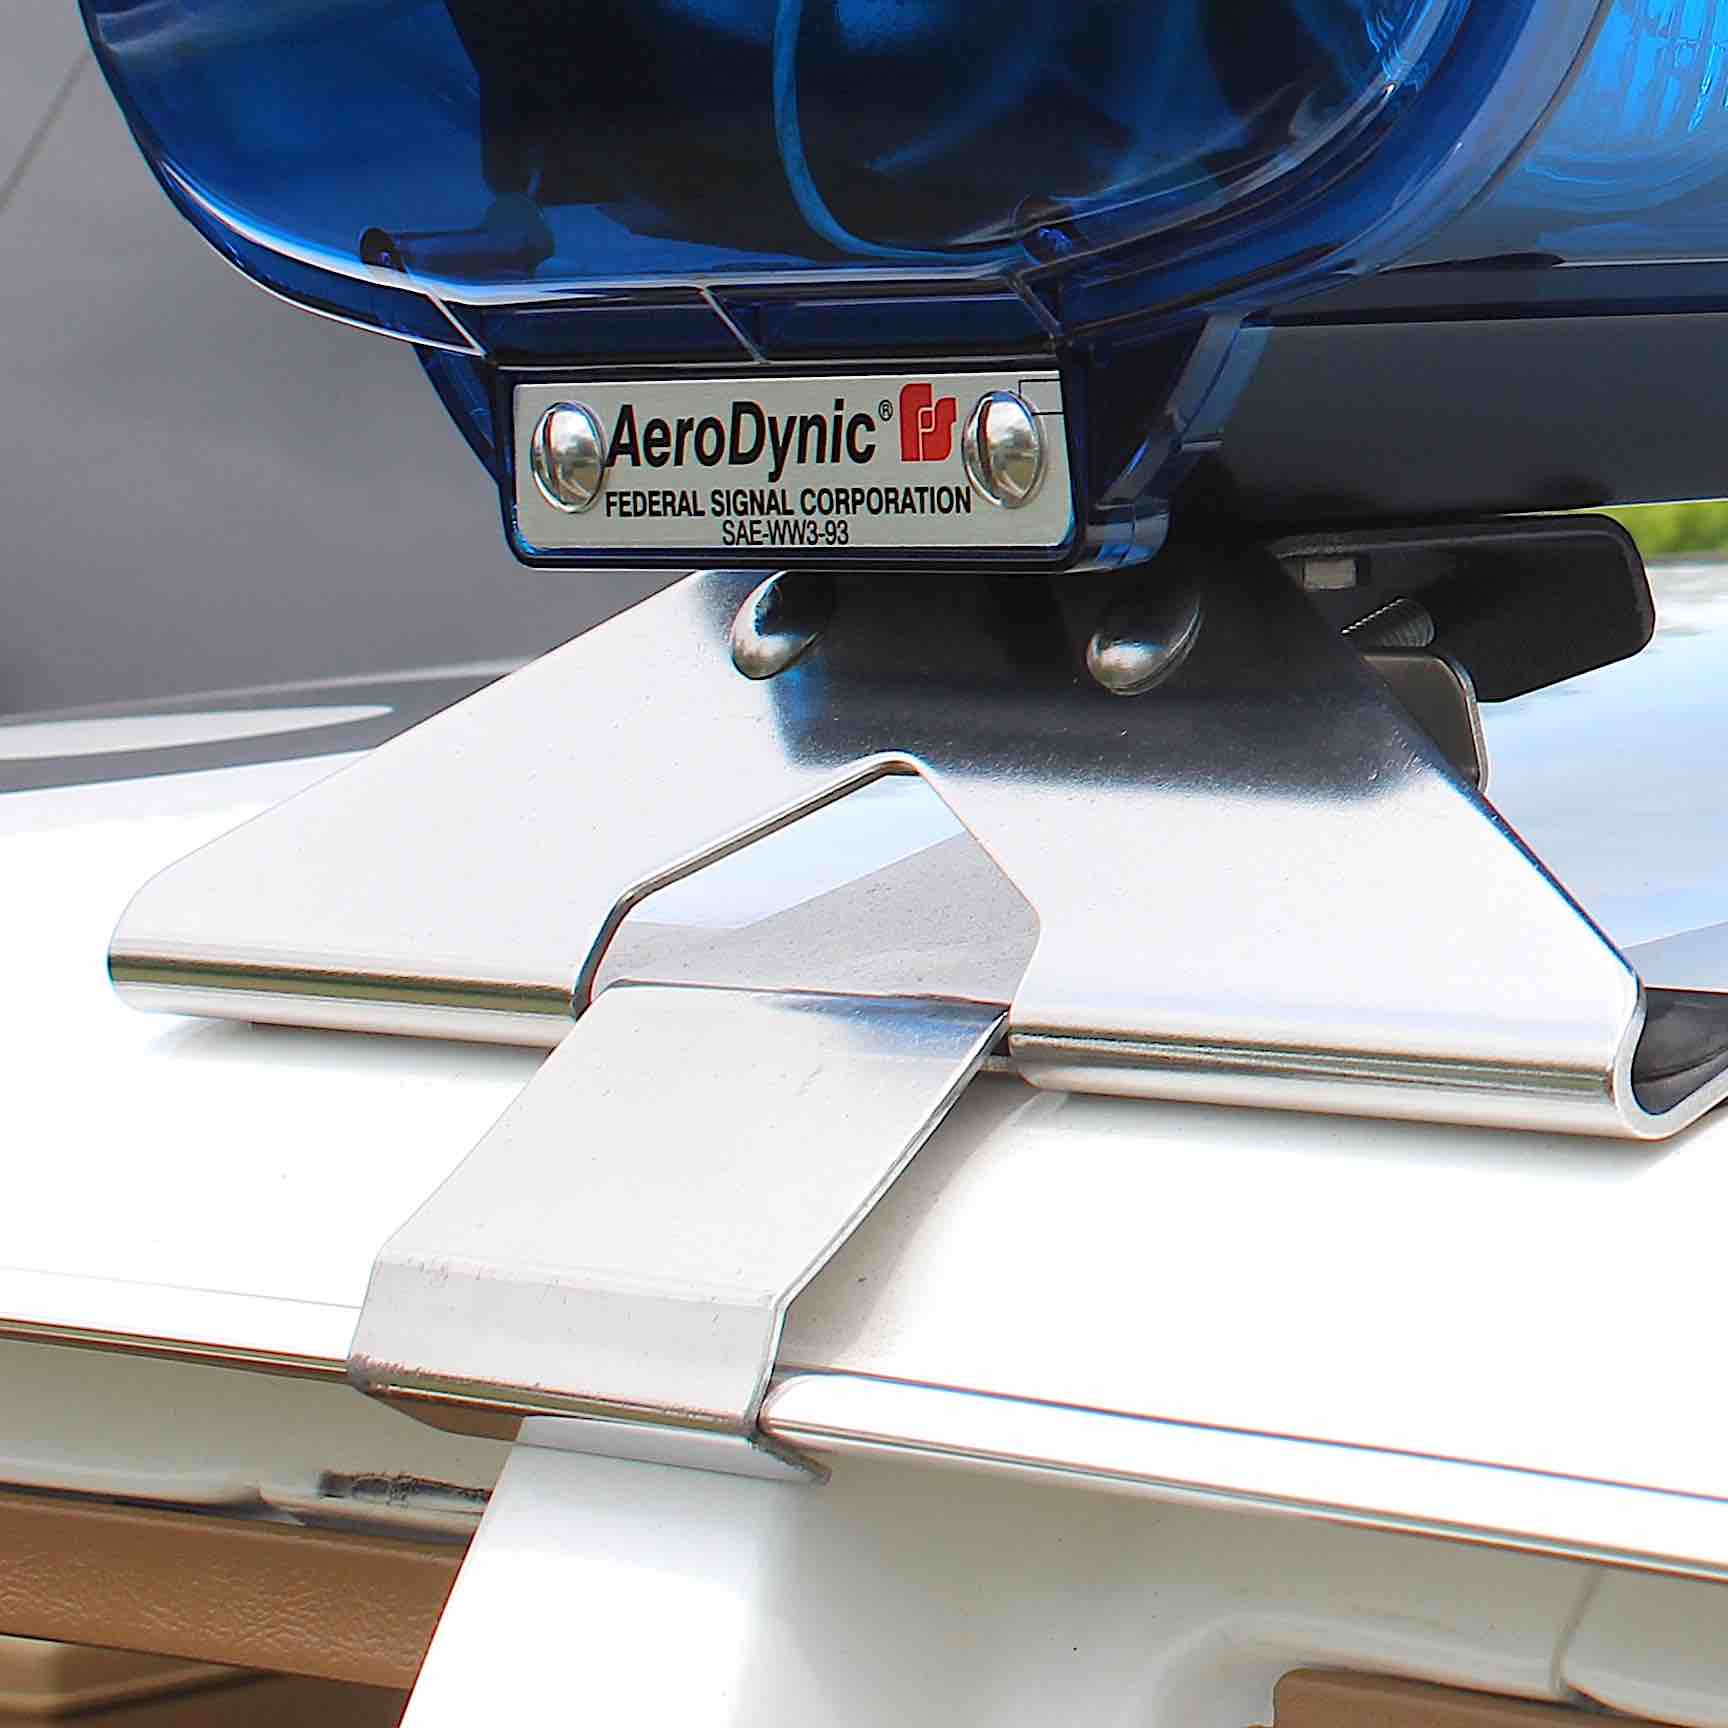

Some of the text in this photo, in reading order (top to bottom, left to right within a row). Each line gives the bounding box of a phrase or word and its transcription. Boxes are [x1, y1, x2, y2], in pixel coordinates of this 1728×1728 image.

[605, 485, 972, 518] FEDERAL SIGNAL CORPORATION
[721, 519, 849, 547] SAE-WW3-93
